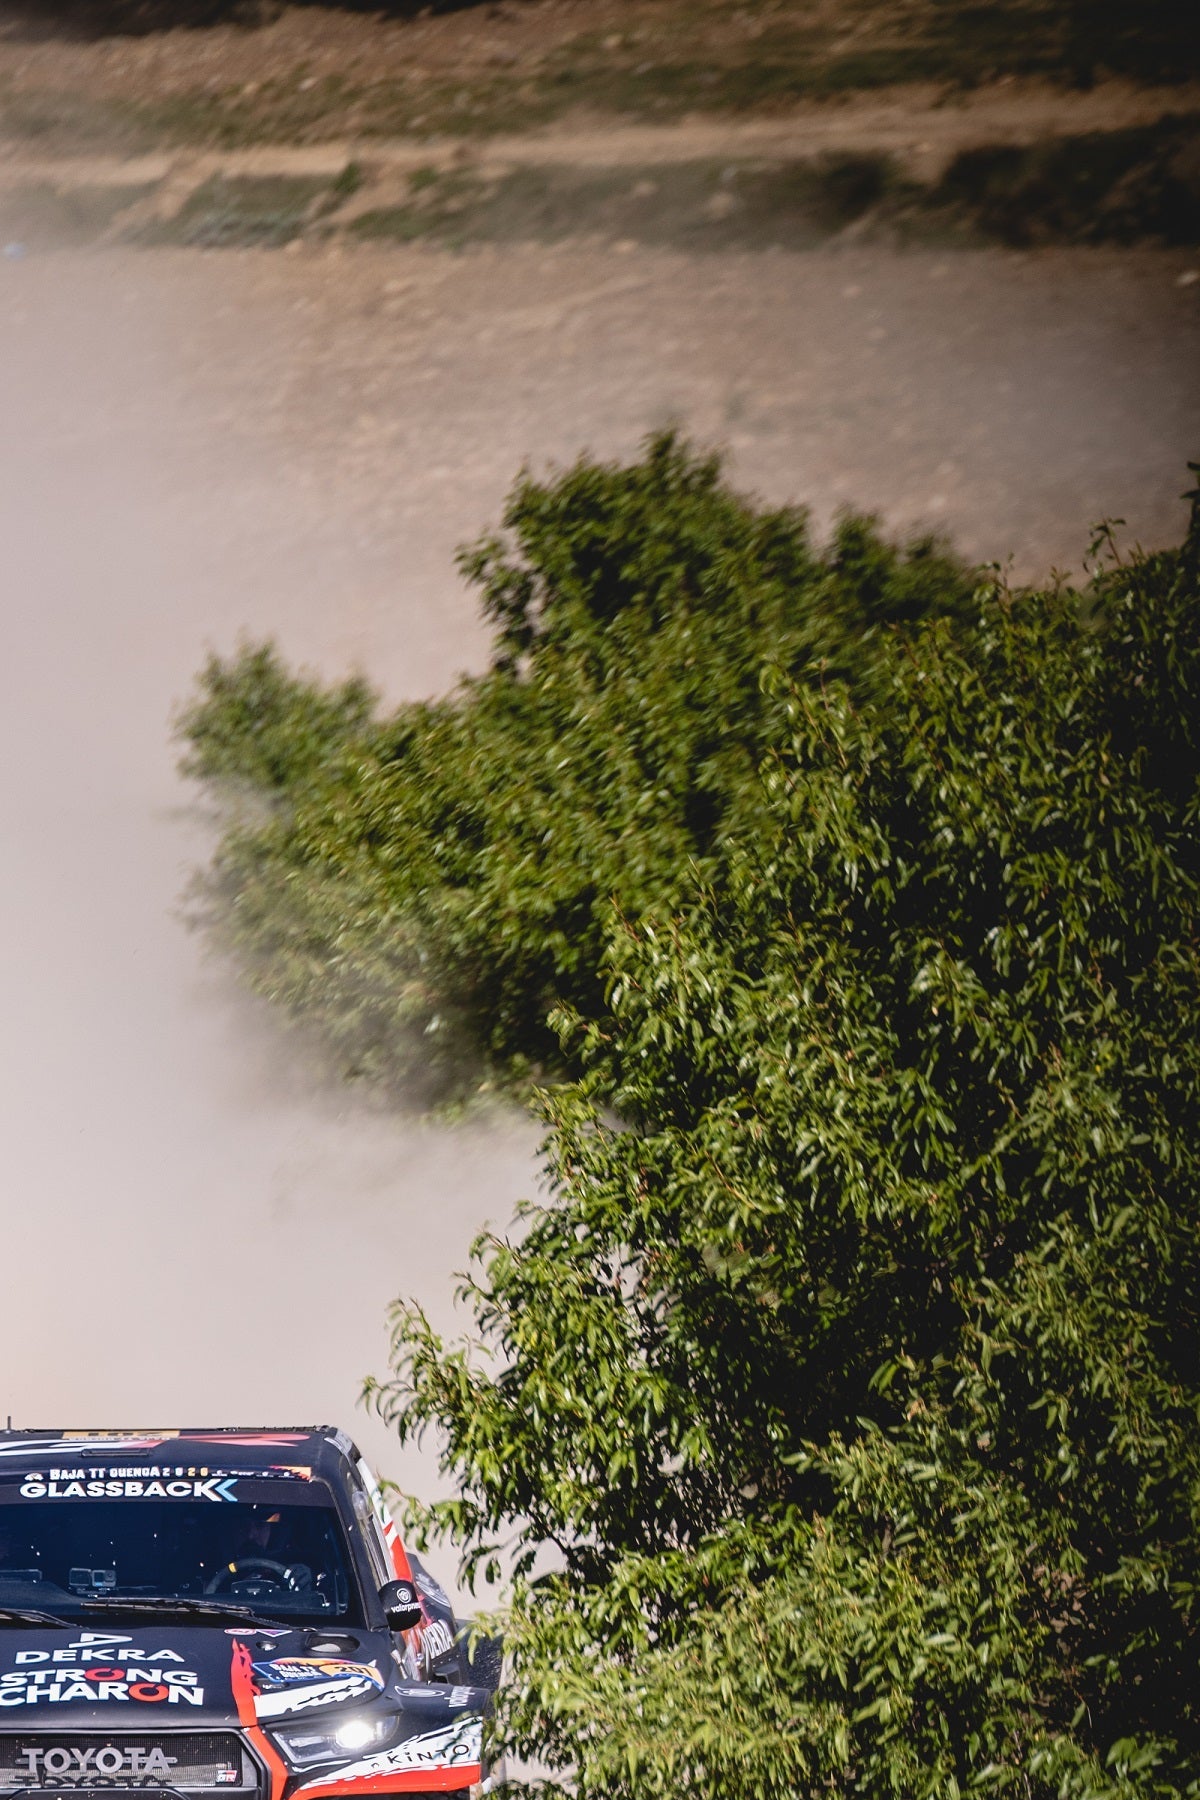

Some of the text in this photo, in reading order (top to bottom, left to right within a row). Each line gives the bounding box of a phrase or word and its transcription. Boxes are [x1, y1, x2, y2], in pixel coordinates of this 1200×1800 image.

[49, 1468, 86, 1480] BAJA
[88, 1467, 106, 1479] TT
[19, 1478, 223, 1502] GLASSBACK
[15, 1648, 185, 1665] DEKRA
[0, 1667, 199, 1688] STRONG
[21, 1747, 172, 1774] TOYOTA
